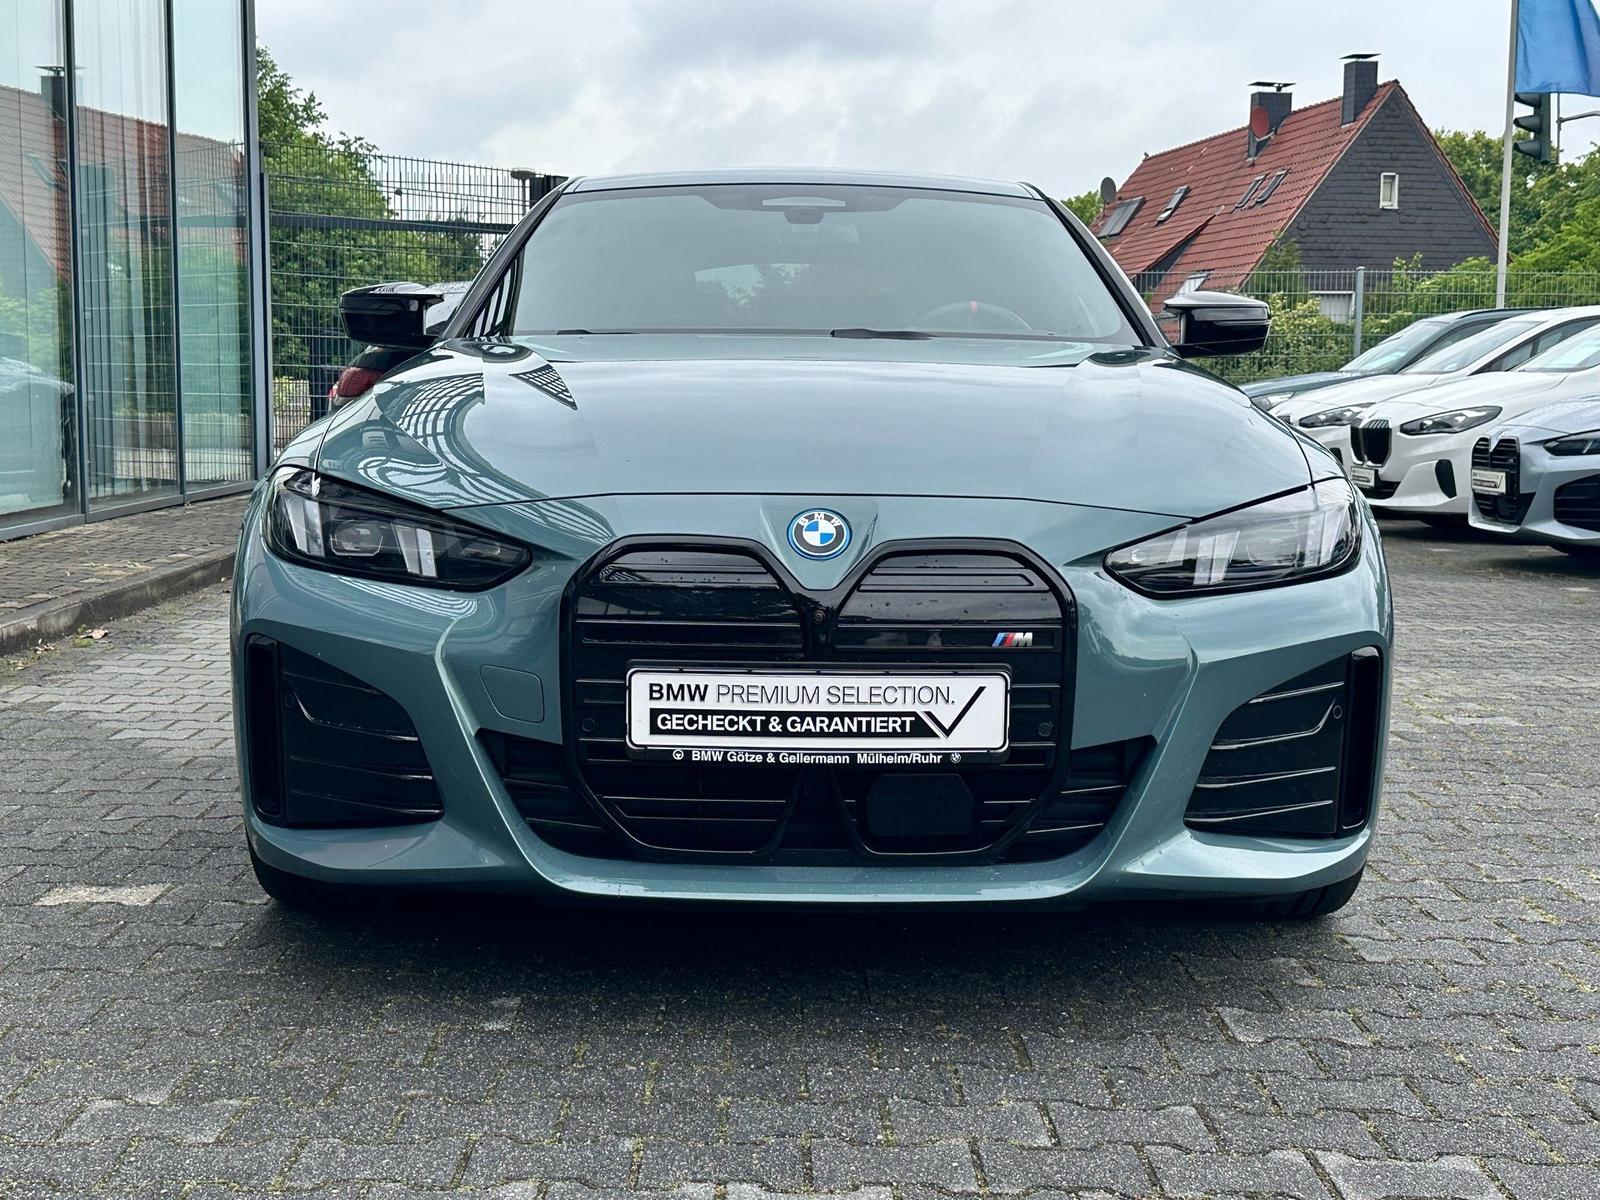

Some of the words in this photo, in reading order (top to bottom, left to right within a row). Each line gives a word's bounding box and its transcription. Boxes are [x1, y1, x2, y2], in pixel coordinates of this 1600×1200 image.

[798, 512, 842, 527] BMW
[649, 683, 709, 701] BMW
[717, 684, 820, 704] PREMIUM
[827, 685, 955, 705] SELECTION.
[657, 713, 766, 731] GECHECKT
[768, 716, 782, 732] &
[786, 716, 916, 733] GARANTIERT
[691, 751, 724, 762] BMW
[727, 751, 763, 763] Götze
[766, 753, 776, 763] &
[779, 752, 850, 764] Gellermann
[857, 753, 942, 764] Mülheim/Ruhr
